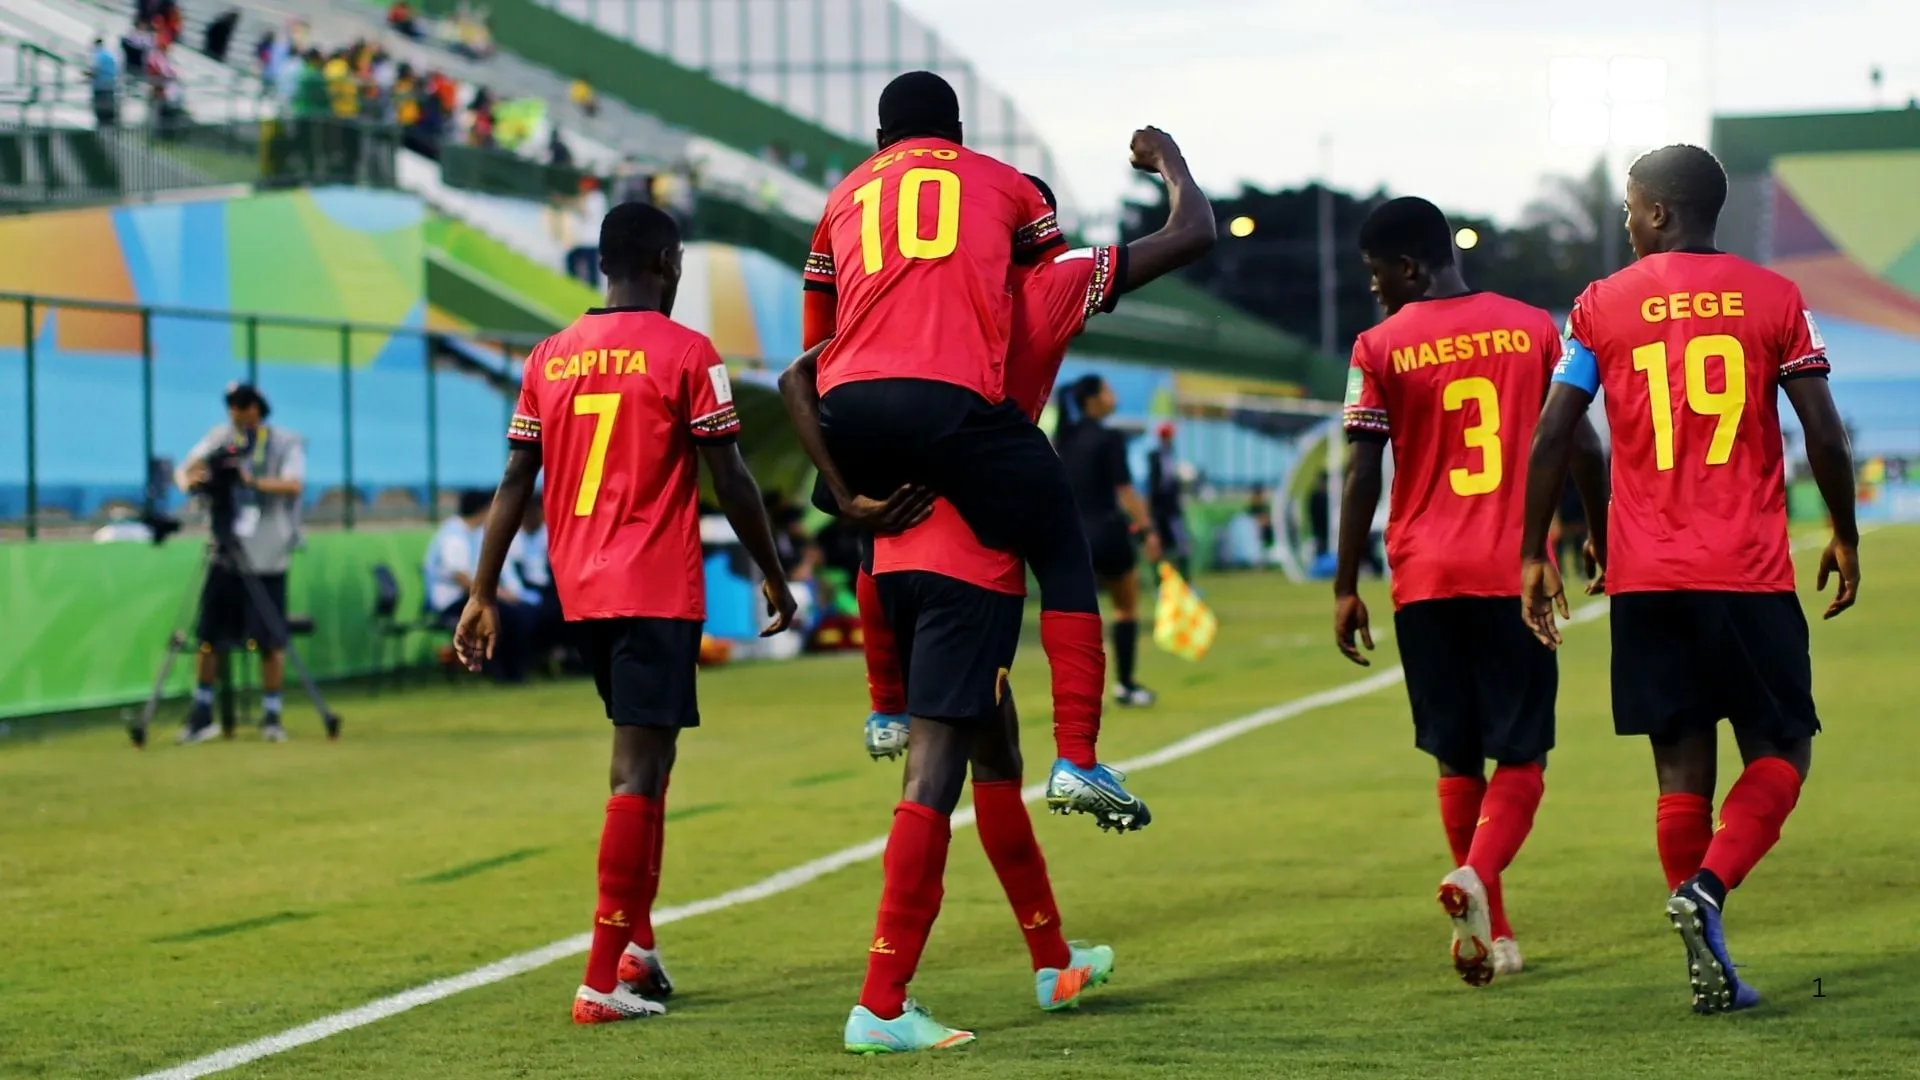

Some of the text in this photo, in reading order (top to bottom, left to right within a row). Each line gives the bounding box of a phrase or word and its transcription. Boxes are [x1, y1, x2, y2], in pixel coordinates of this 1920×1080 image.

[870, 148, 959, 173] ZITO
[853, 167, 961, 275] 10
[1640, 291, 1745, 323] GEGE
[543, 348, 648, 382] CAPITA
[1391, 328, 1532, 375] MAESTRO
[1442, 376, 1503, 497] 3
[1632, 334, 1746, 472] 19
[573, 392, 622, 517] 7
